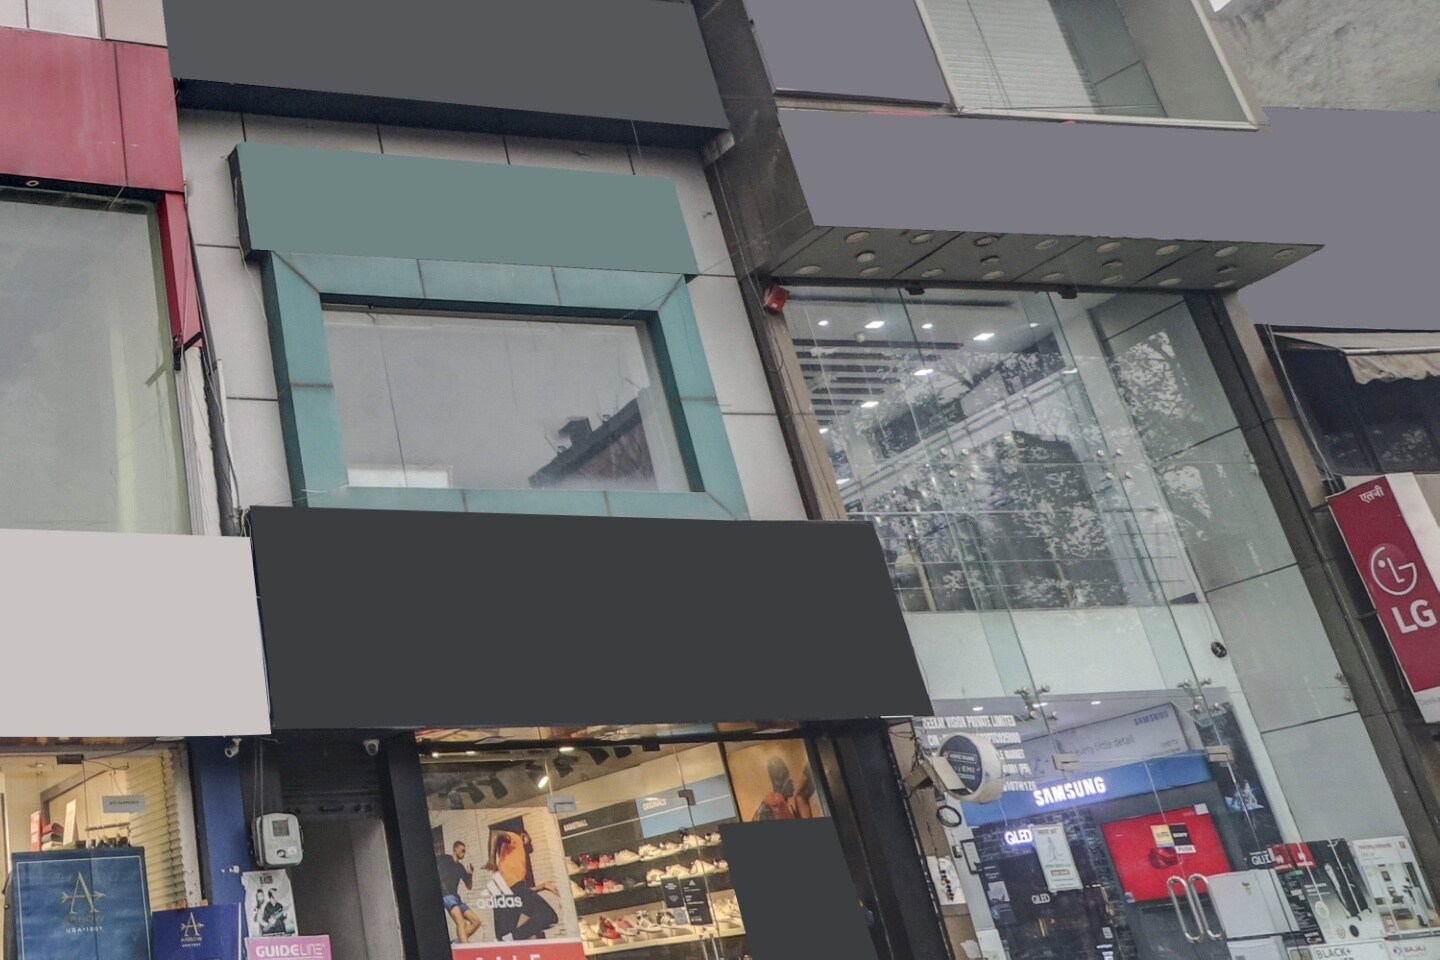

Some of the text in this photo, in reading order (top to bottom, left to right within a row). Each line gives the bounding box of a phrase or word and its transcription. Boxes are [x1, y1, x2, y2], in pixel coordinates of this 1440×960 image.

[1391, 598, 1438, 634] LG
[1034, 776, 1106, 807] SAMSUNG
[1004, 828, 1033, 845] QLED
[476, 894, 523, 909] adidas
[1031, 893, 1050, 904] QLED
[1316, 948, 1352, 960] BLACK+
[1404, 945, 1427, 954] BAJAJ
